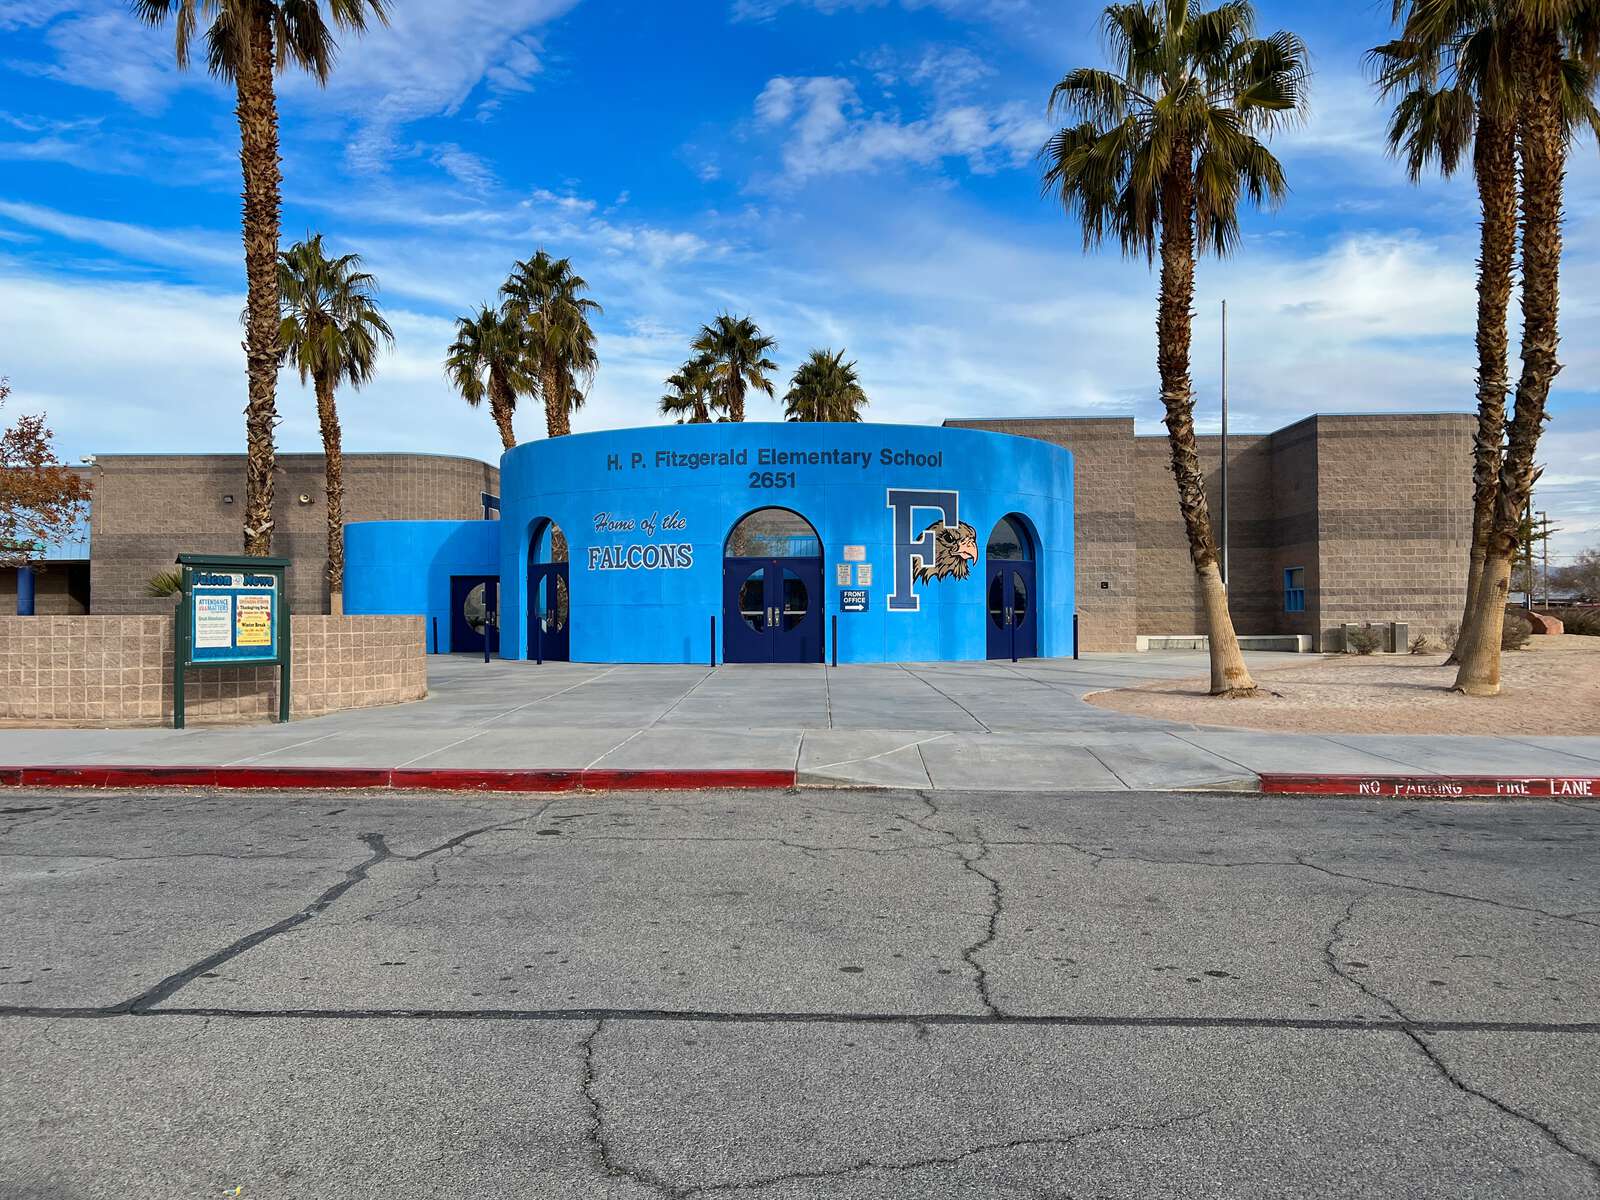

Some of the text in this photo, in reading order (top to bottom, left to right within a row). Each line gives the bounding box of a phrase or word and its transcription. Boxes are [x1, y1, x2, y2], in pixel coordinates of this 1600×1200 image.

[608, 448, 943, 470] H. P. Fitzgerald Elementary School
[749, 472, 796, 489] 2651
[594, 510, 687, 537] Home of the
[588, 543, 693, 570] FALCONS
[886, 488, 959, 612] F
[1359, 780, 1380, 793] NO
[1496, 780, 1530, 794] FIRE
[1550, 779, 1593, 795] LANE
